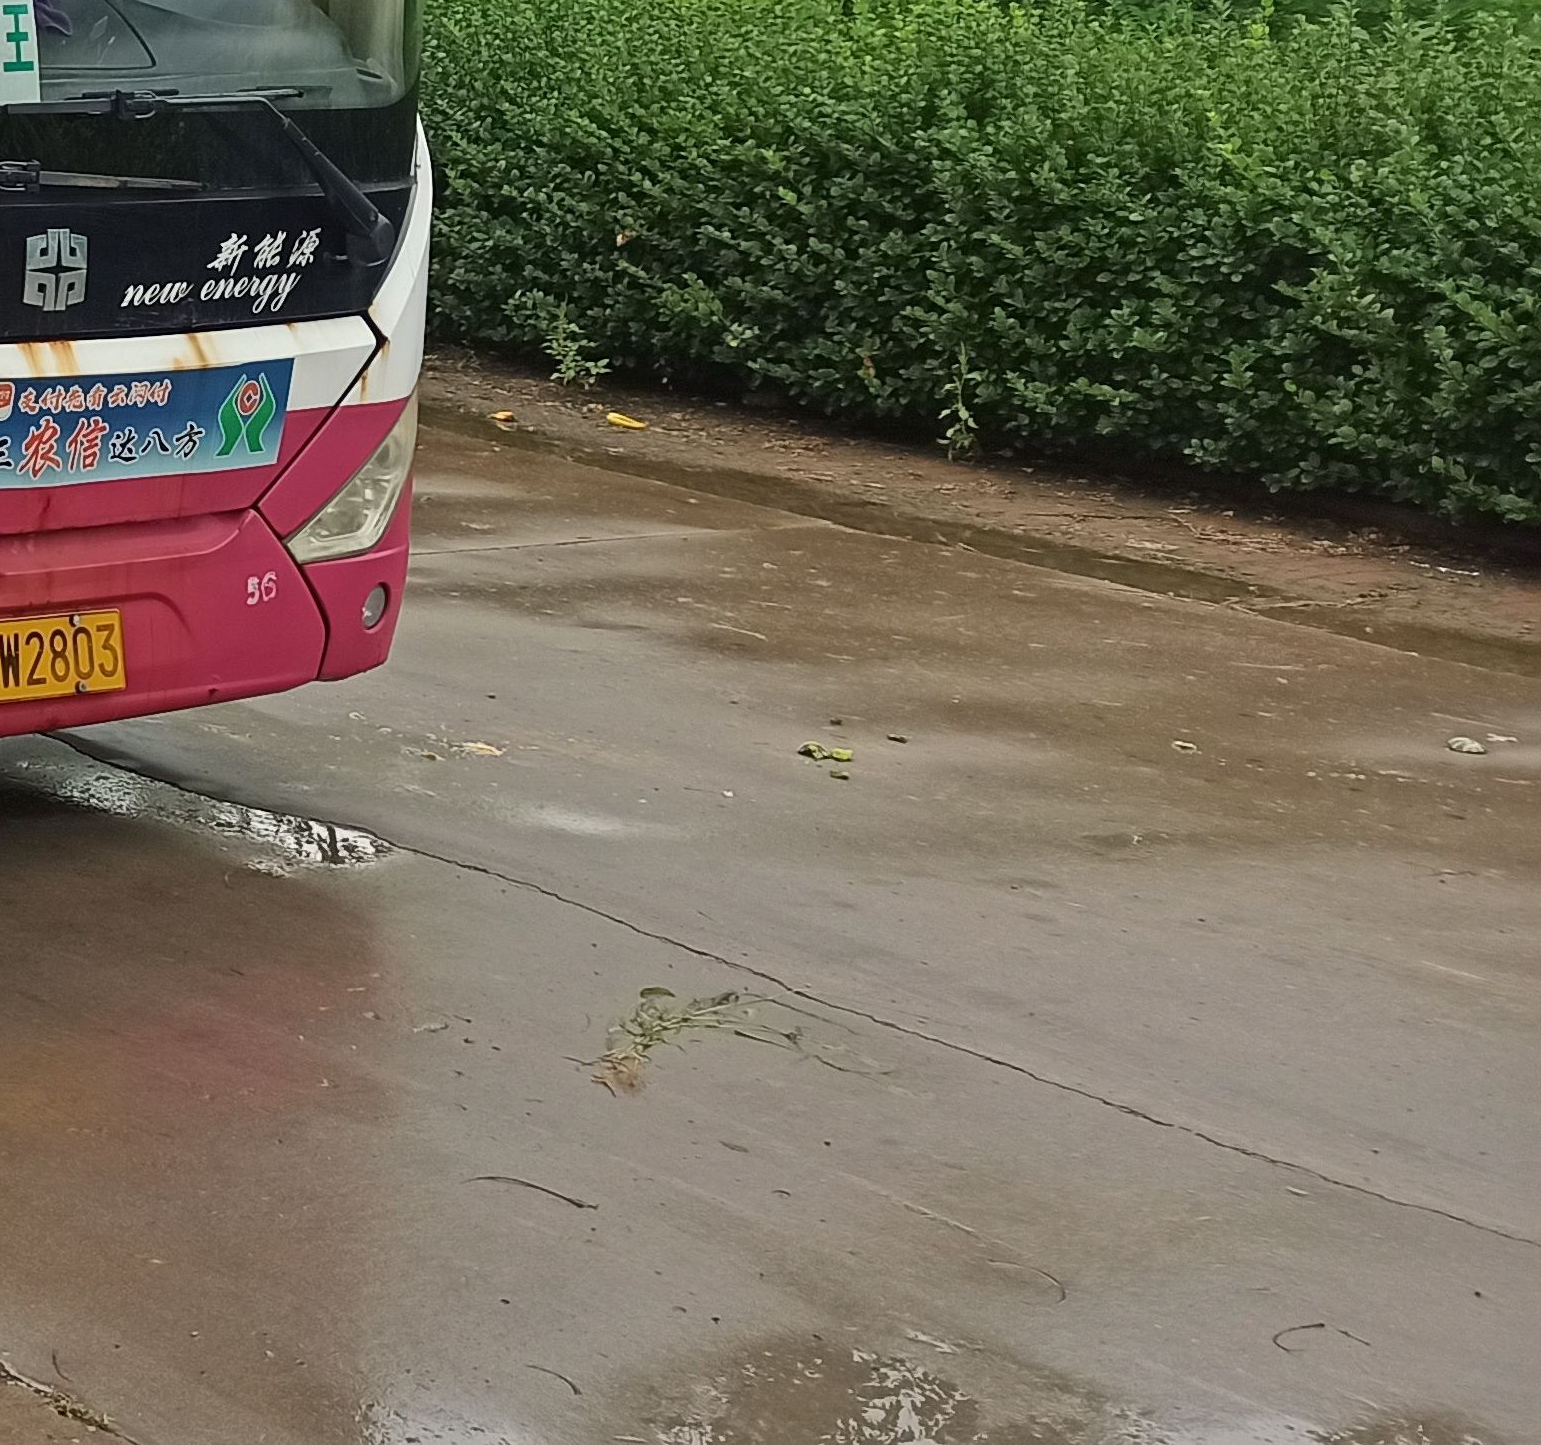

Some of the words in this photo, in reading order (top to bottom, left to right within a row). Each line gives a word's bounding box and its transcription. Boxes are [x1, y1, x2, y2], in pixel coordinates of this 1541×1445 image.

[206, 227, 322, 276] 新能源
[119, 281, 195, 308] new
[199, 271, 303, 314] energy
